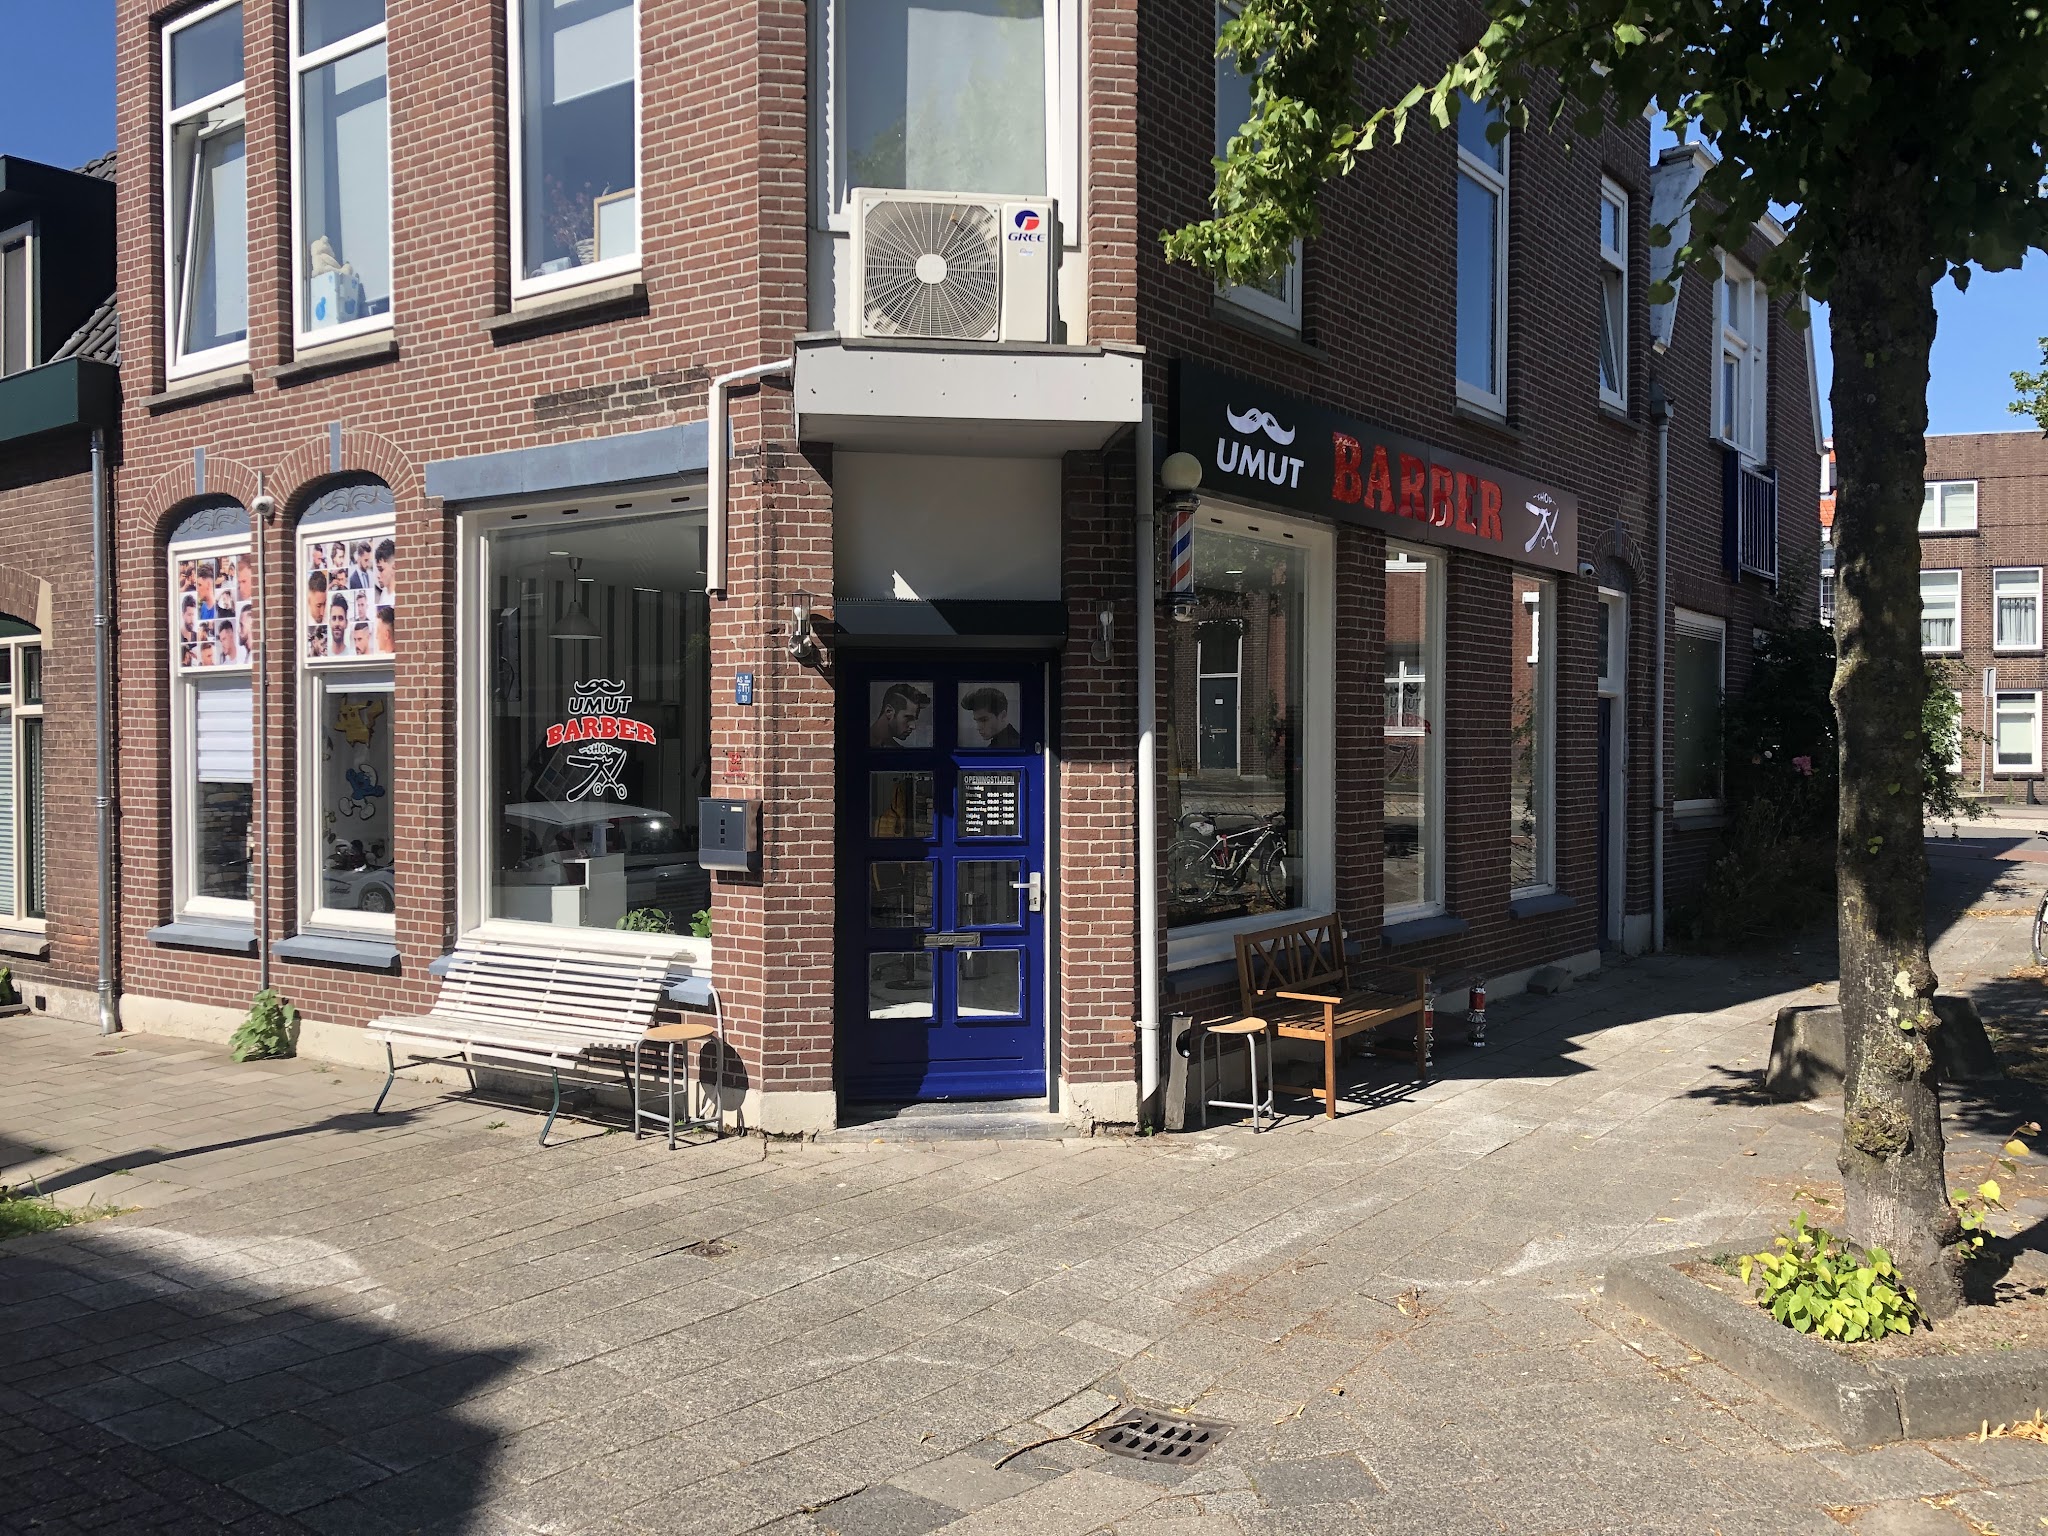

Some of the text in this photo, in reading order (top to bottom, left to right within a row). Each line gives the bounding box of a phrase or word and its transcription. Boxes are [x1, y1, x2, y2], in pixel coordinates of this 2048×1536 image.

[1008, 232, 1046, 242] GREE
[1216, 437, 1305, 489] UMUT
[1331, 431, 1504, 542] BARBER
[568, 695, 632, 715] UMUT
[546, 716, 656, 748] BARBER
[586, 743, 615, 755] SHOP
[964, 776, 1014, 785] OPENINGSTIJDEN
